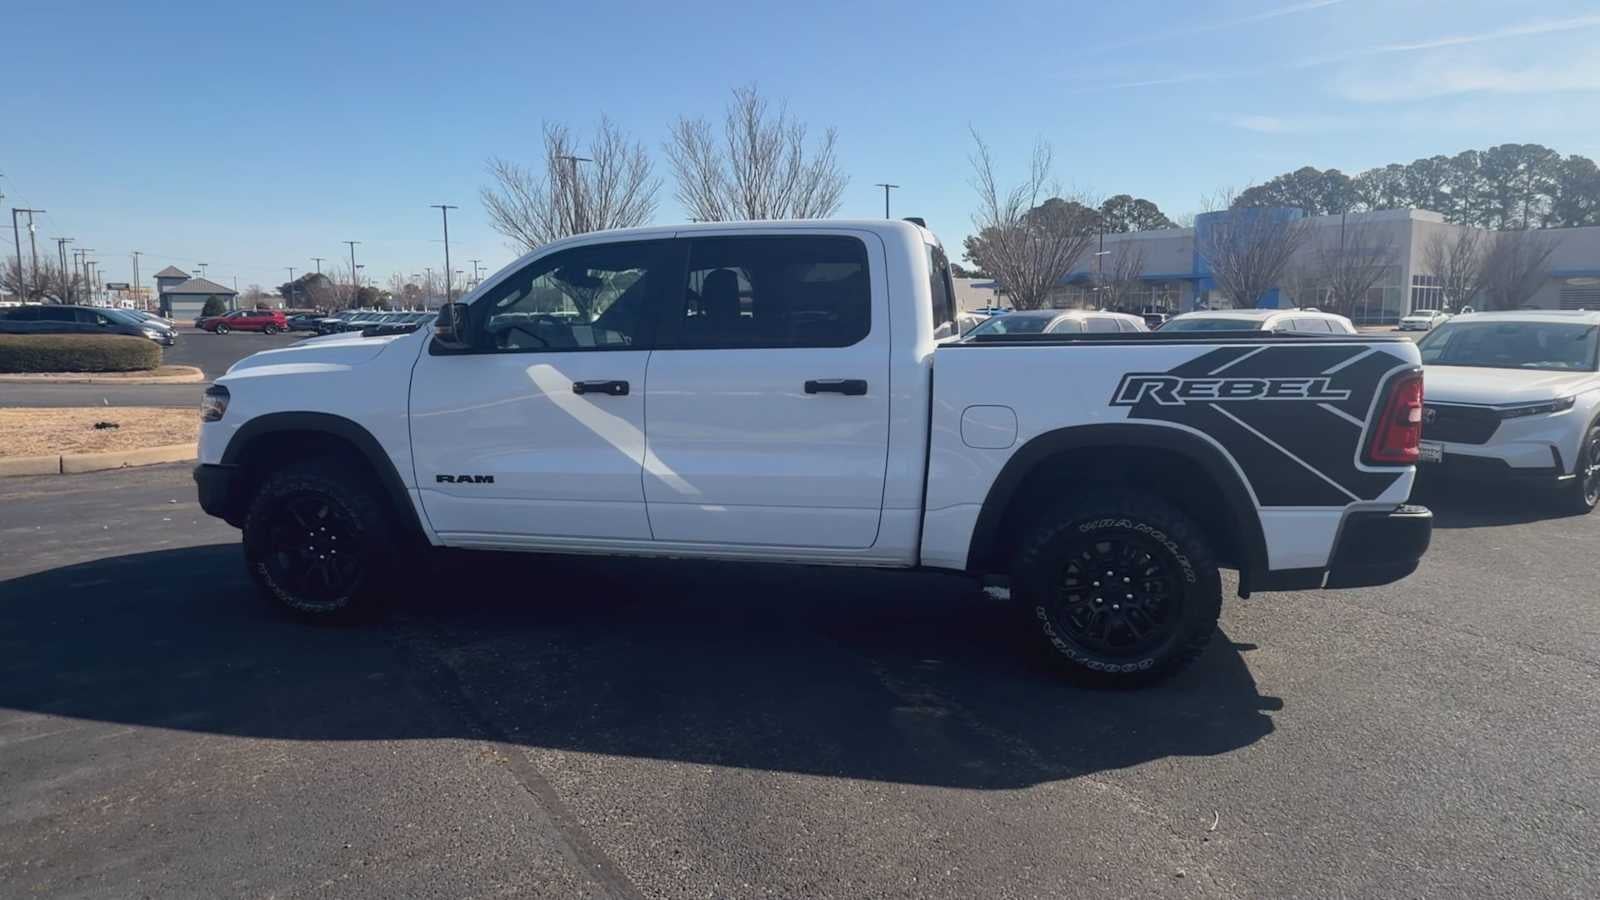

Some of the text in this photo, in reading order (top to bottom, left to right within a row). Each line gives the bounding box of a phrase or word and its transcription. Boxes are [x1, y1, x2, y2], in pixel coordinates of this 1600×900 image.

[1112, 373, 1352, 406] REBEL
[436, 474, 494, 483] RAM
[1035, 606, 1154, 673] GOODYEAR
